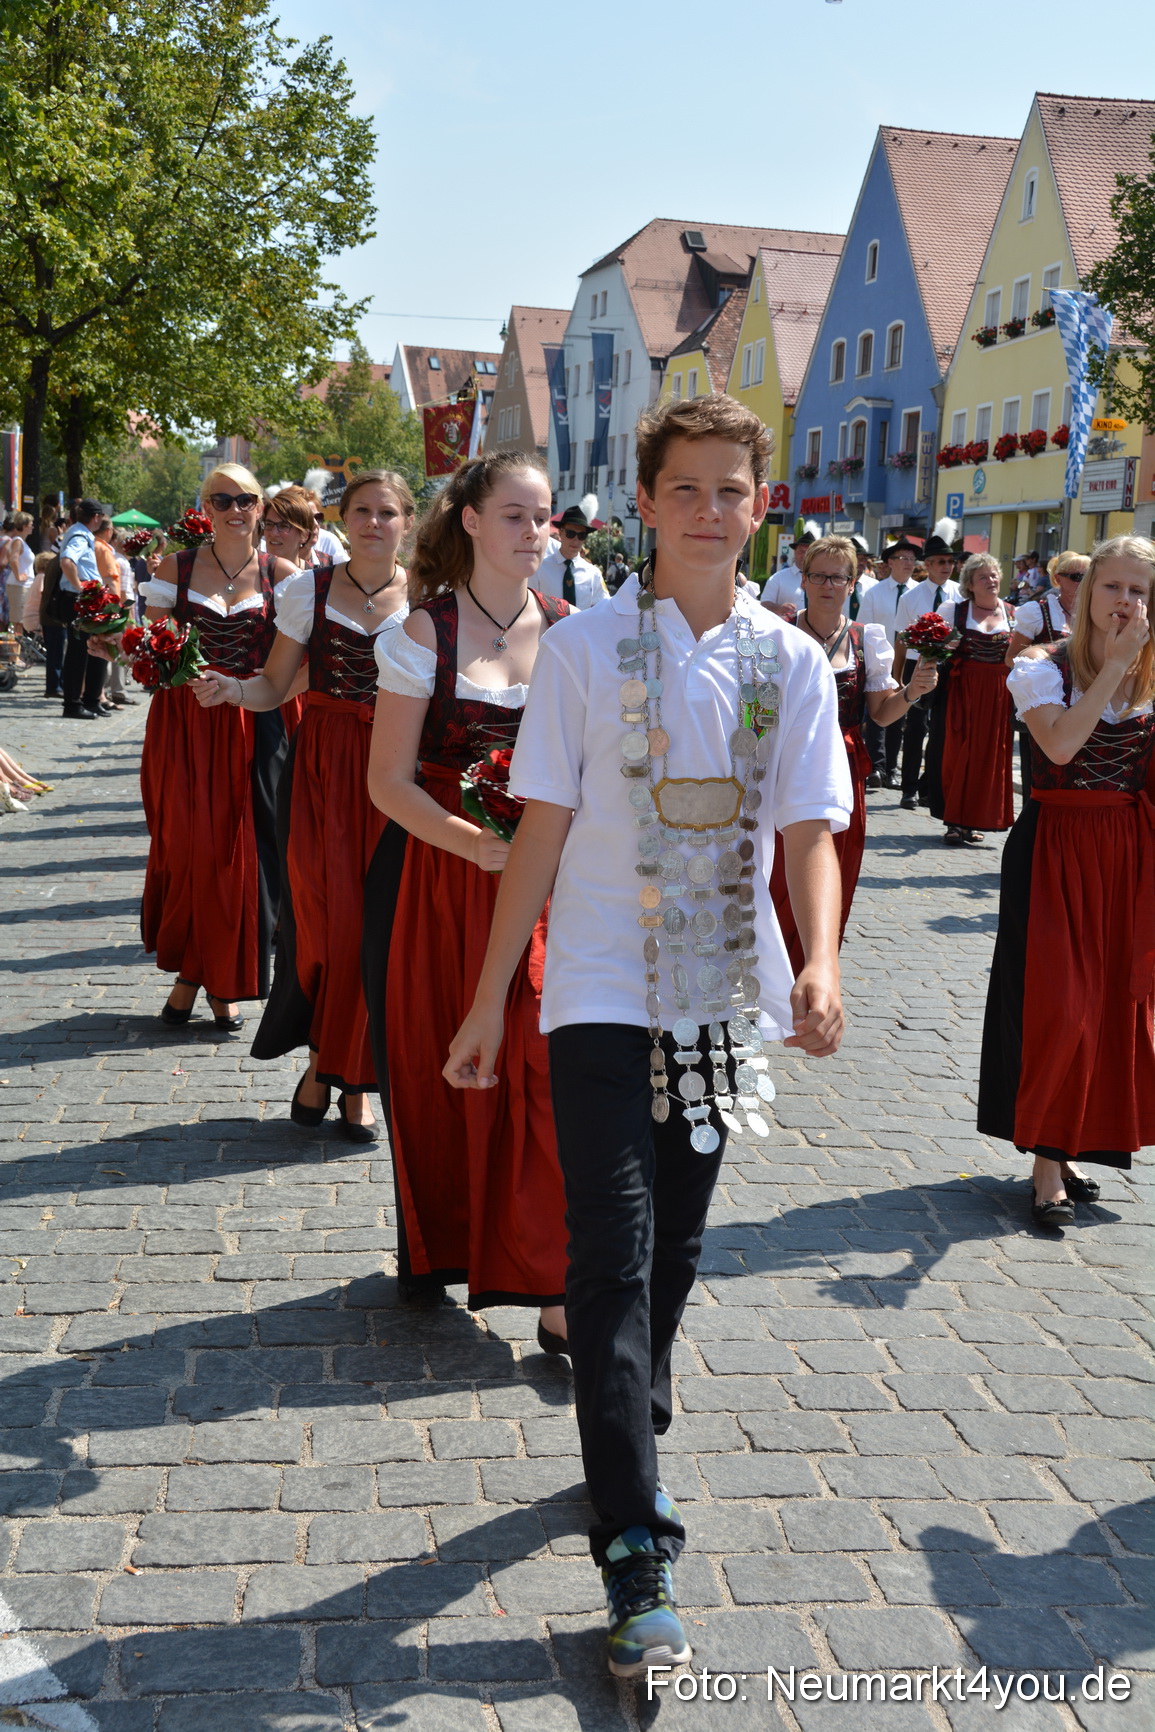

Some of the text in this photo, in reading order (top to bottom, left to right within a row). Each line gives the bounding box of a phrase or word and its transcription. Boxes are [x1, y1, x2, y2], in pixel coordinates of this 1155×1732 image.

[1096, 421, 1113, 429] KINO
[1124, 459, 1134, 508] KINO
[949, 496, 960, 517] P
